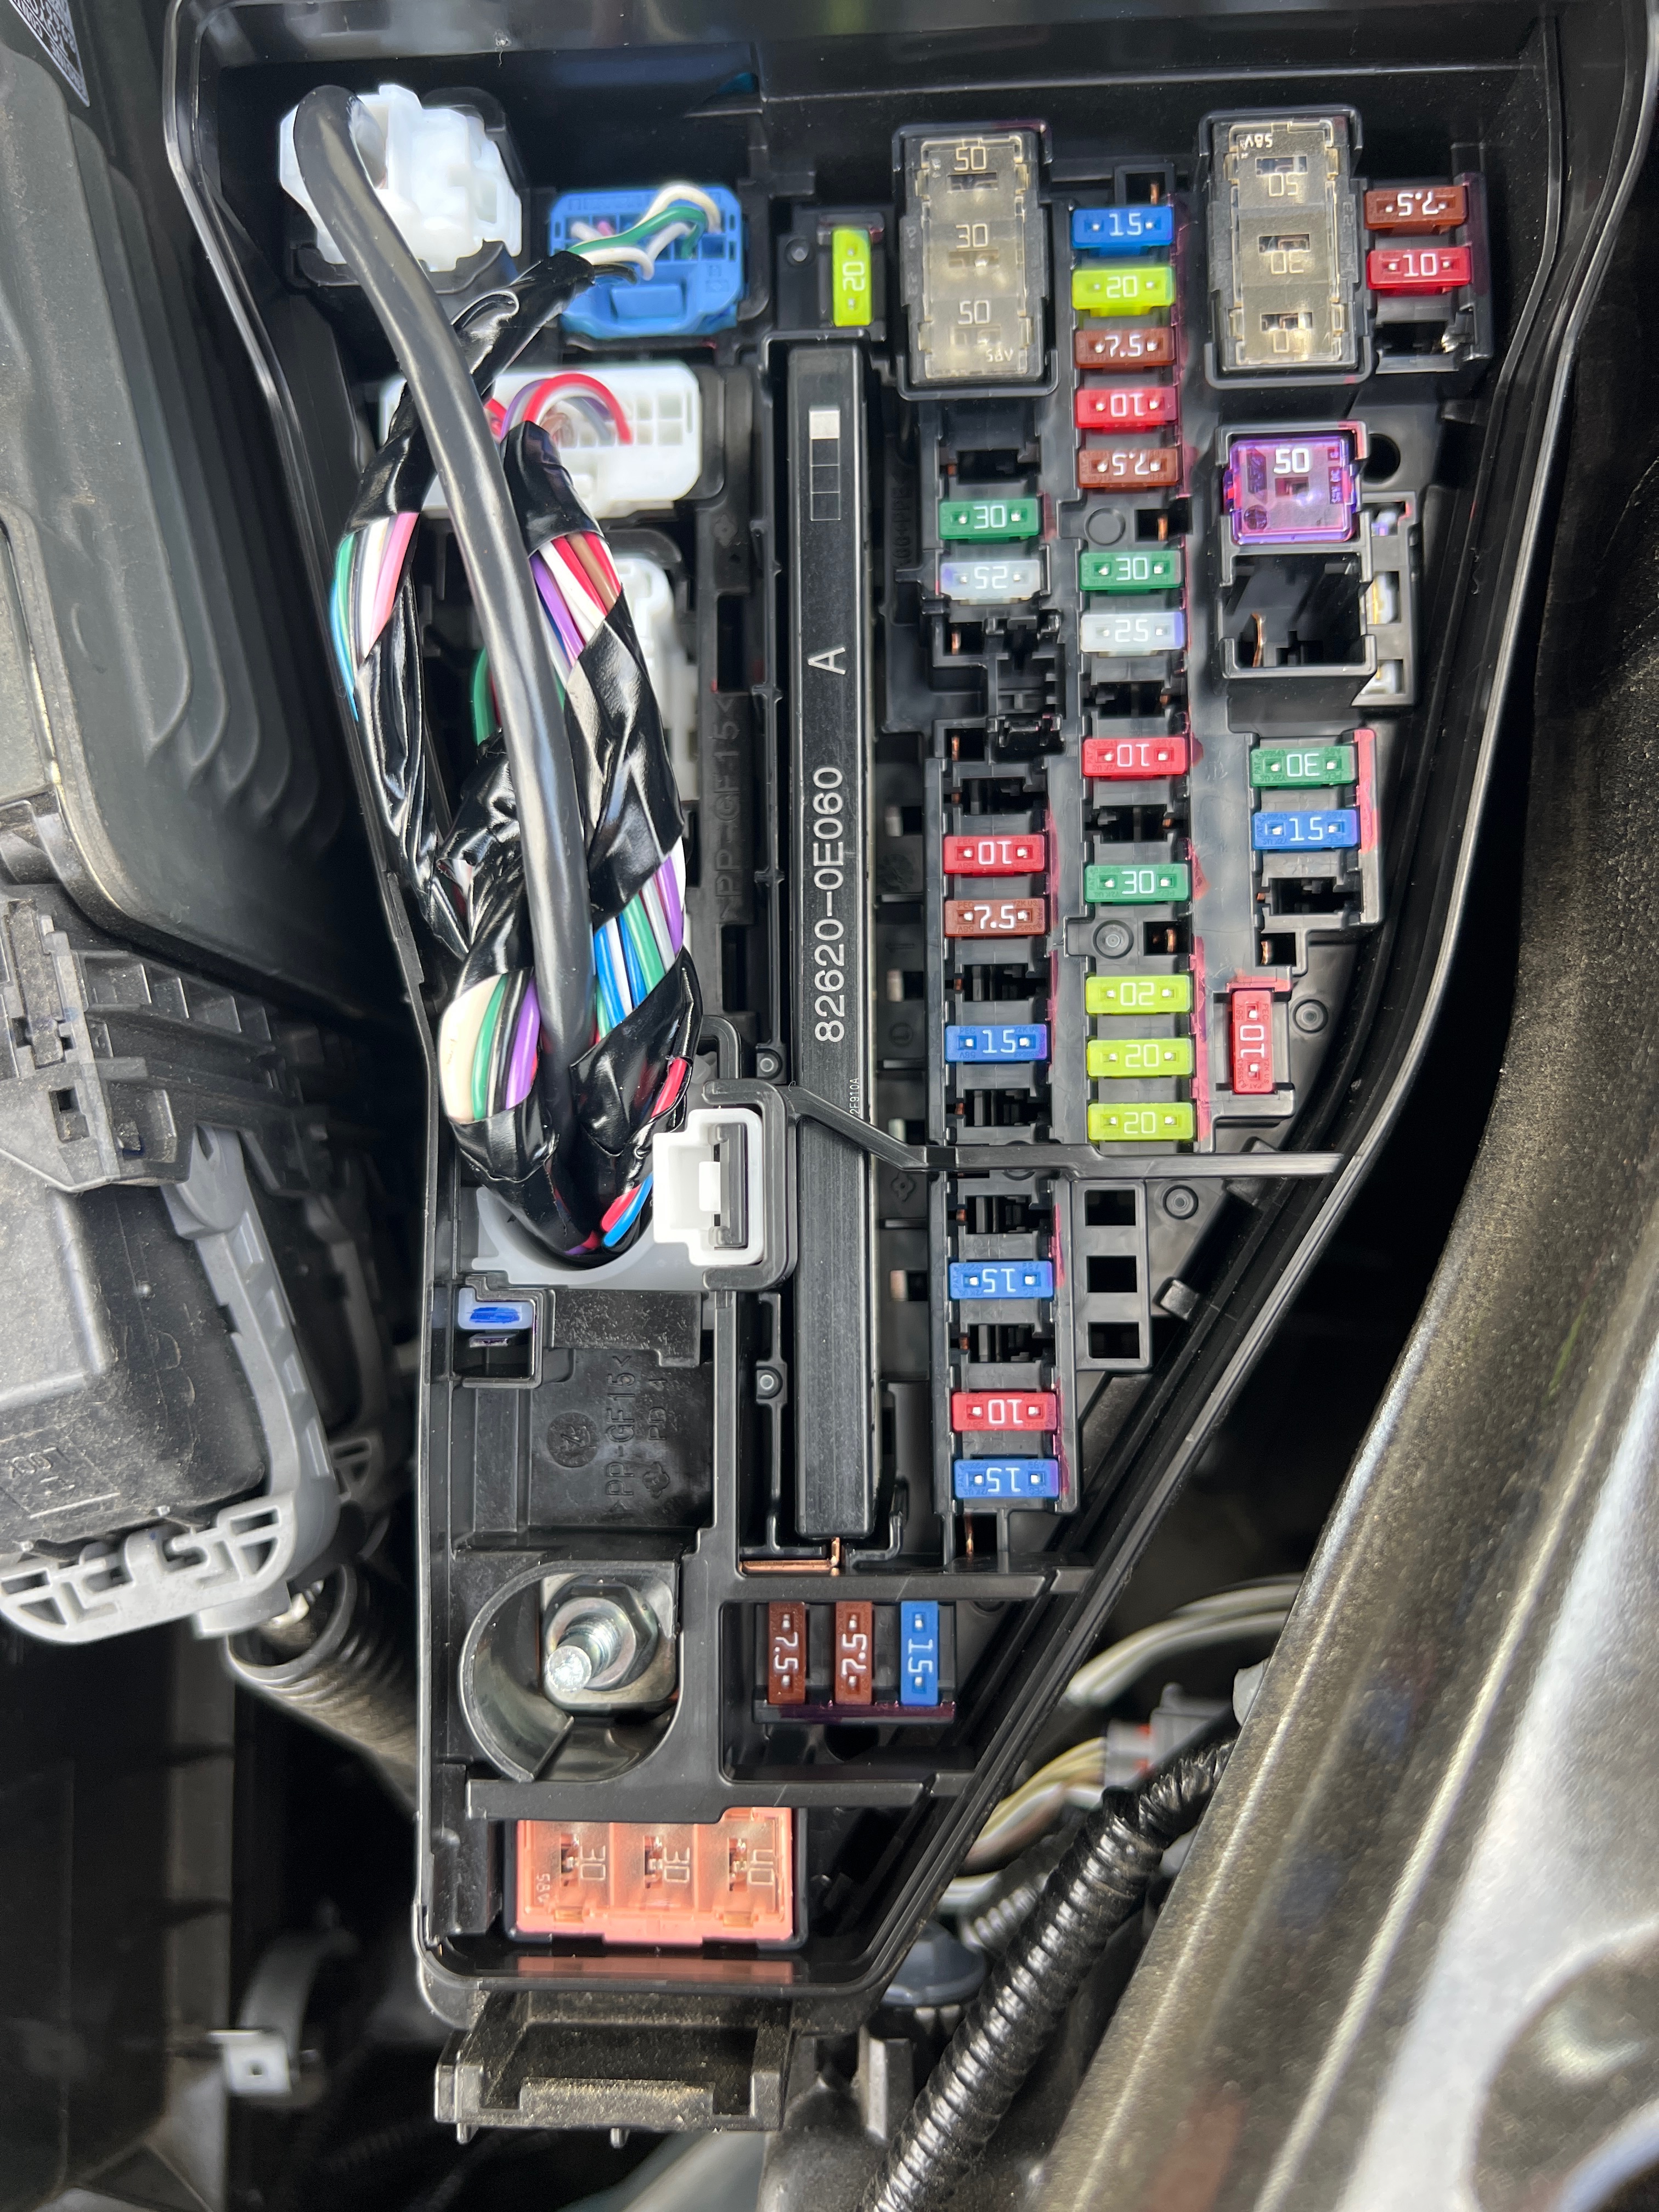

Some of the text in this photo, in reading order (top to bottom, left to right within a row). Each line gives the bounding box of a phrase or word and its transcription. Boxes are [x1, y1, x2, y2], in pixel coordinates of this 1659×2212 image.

[954, 146, 987, 172] 50
[1397, 191, 1438, 216] 7.5
[955, 223, 989, 248] 30
[1109, 213, 1142, 236] 15
[1271, 249, 1305, 274] 30
[1402, 253, 1437, 277] 10
[843, 261, 865, 291] 20
[1106, 276, 1138, 298] 20
[957, 301, 991, 325] 50
[1104, 335, 1143, 358] 7.5
[1110, 393, 1146, 417] 10
[1111, 453, 1152, 476] 7.5
[1273, 447, 1310, 473] 50
[973, 505, 1006, 529] 30
[974, 566, 1008, 590] 25
[1116, 557, 1149, 581] 30
[1115, 620, 1149, 643] 25
[808, 647, 847, 675] A
[1116, 744, 1150, 767] 10
[1285, 753, 1321, 777] 30
[1289, 817, 1323, 842] 15
[978, 841, 1013, 865] 10
[1121, 871, 1155, 894] 30
[812, 767, 845, 1042] 82620-0E060
[974, 906, 1014, 930] 7.5
[1120, 983, 1155, 1007] 20
[982, 1029, 1016, 1053] 15
[1240, 1024, 1265, 1058] 10
[1125, 1044, 1159, 1068] 20
[1263, 1073, 1269, 1084] US
[849, 1077, 860, 1115] 2F910A
[1124, 1111, 1156, 1134] 20
[982, 1268, 1017, 1293] 15
[988, 1399, 1023, 1425] 10
[986, 1467, 1021, 1493] 15
[774, 1632, 799, 1670] 7.5
[842, 1634, 867, 1675] 7.5
[907, 1639, 933, 1674] 15
[579, 1846, 606, 1881] 30
[663, 1846, 691, 1883] 30
